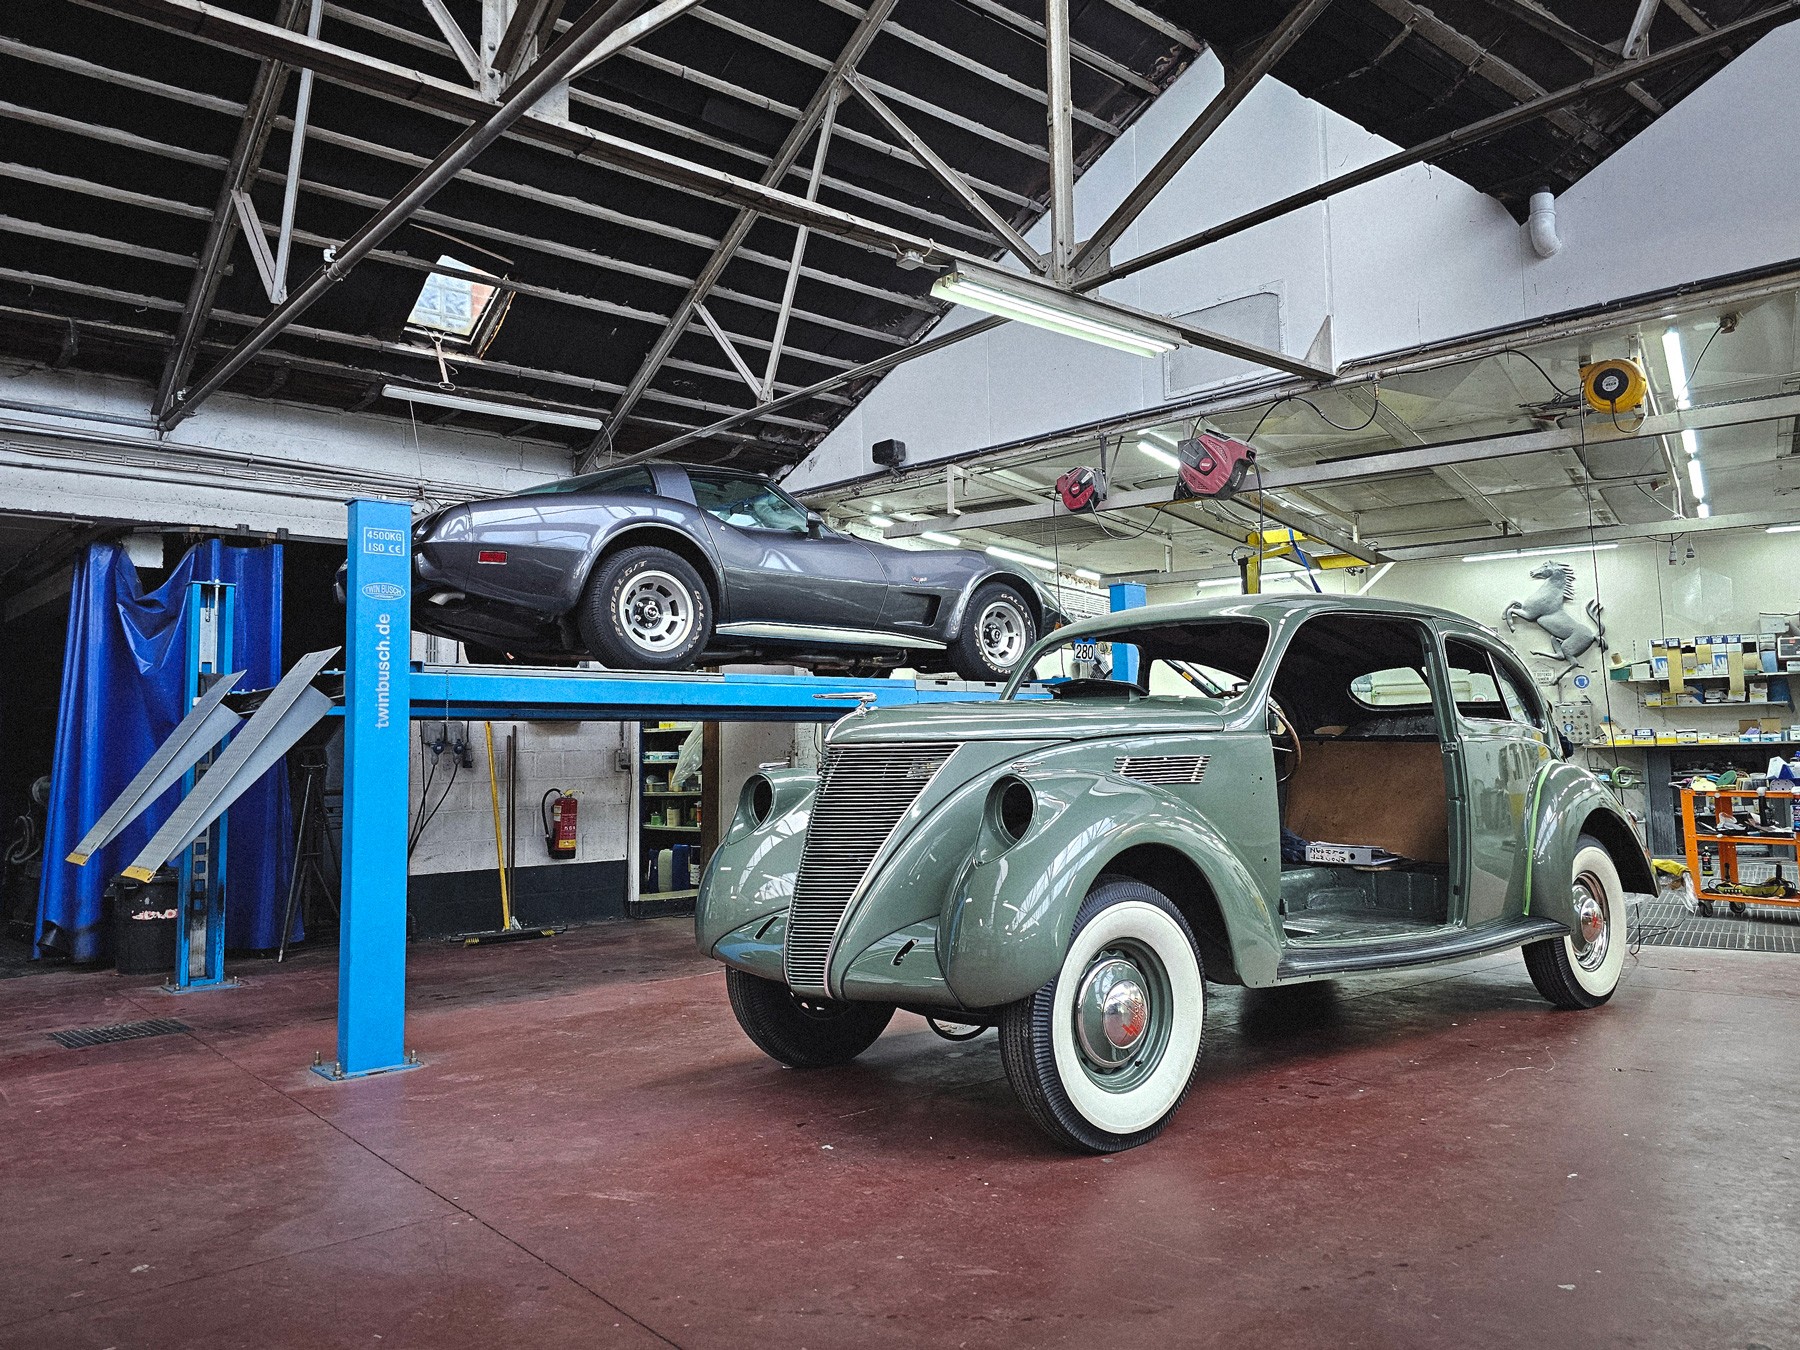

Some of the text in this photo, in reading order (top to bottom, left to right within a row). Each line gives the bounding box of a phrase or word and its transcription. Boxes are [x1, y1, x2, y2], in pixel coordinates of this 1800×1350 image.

[367, 530, 402, 542] 4500KG
[368, 542, 385, 552] ISO
[365, 584, 402, 596] TWIN BUSCH
[1001, 593, 1032, 628] GALAXY
[1076, 644, 1094, 660] 280
[375, 613, 391, 728] twinbusch.de
